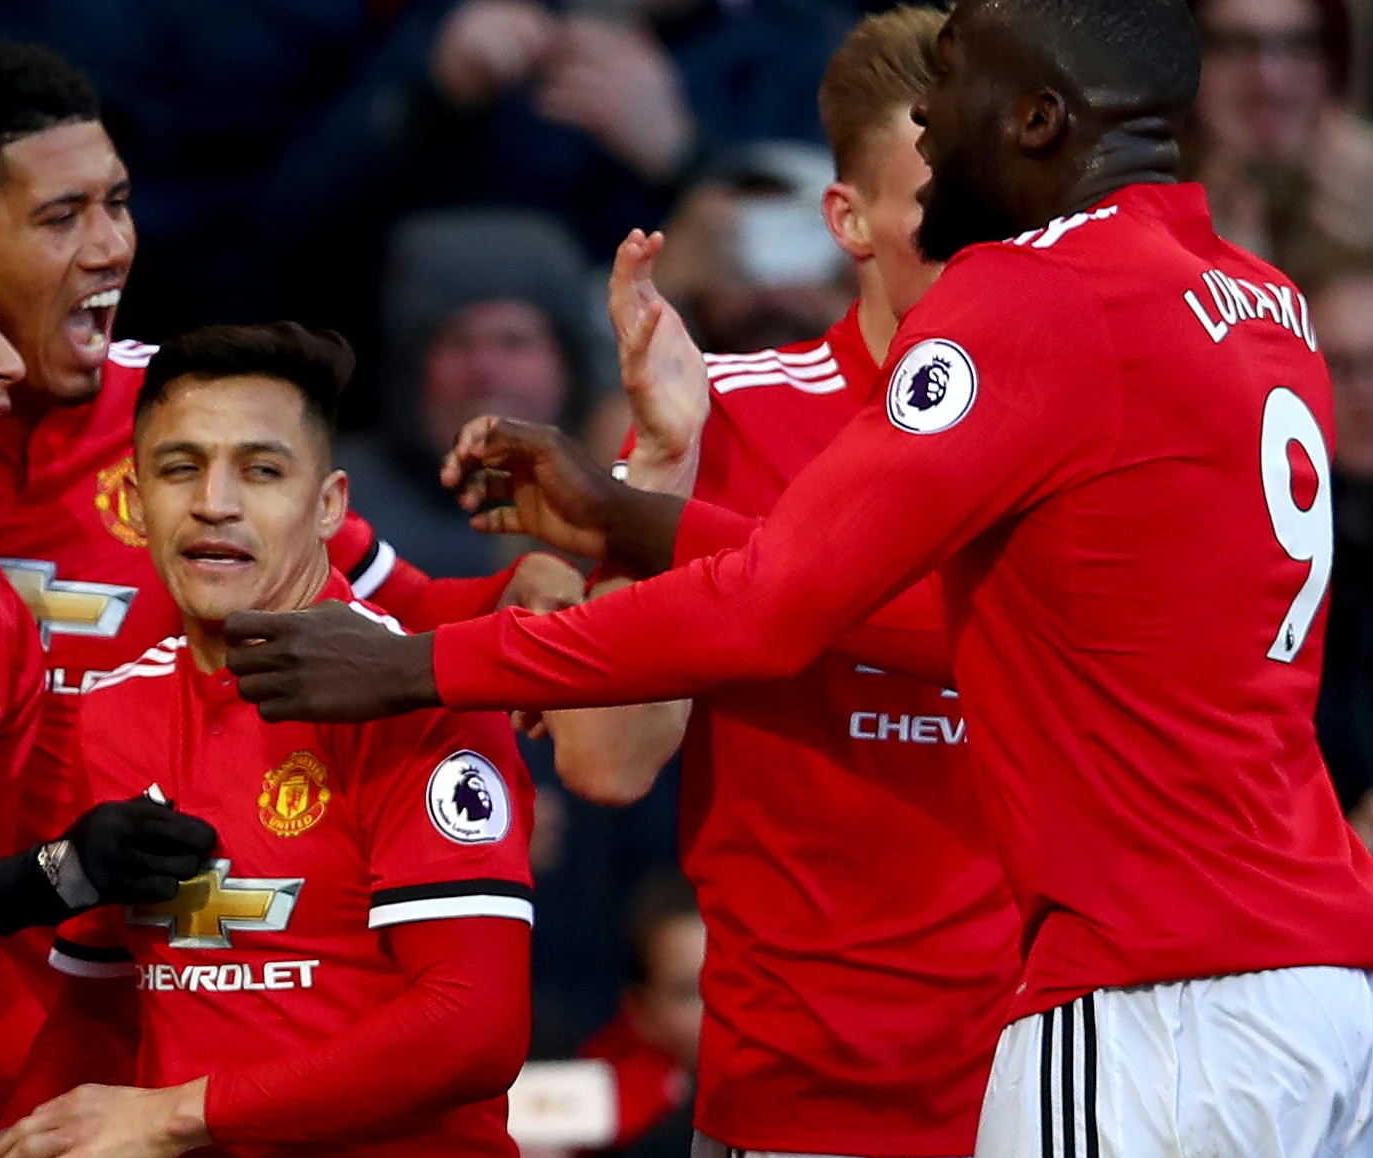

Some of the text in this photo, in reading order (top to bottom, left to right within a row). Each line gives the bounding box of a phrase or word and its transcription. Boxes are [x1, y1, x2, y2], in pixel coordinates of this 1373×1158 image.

[1184, 268, 1317, 353] LUKAKU
[1260, 385, 1333, 663] 9
[848, 710, 969, 745] CHEV
